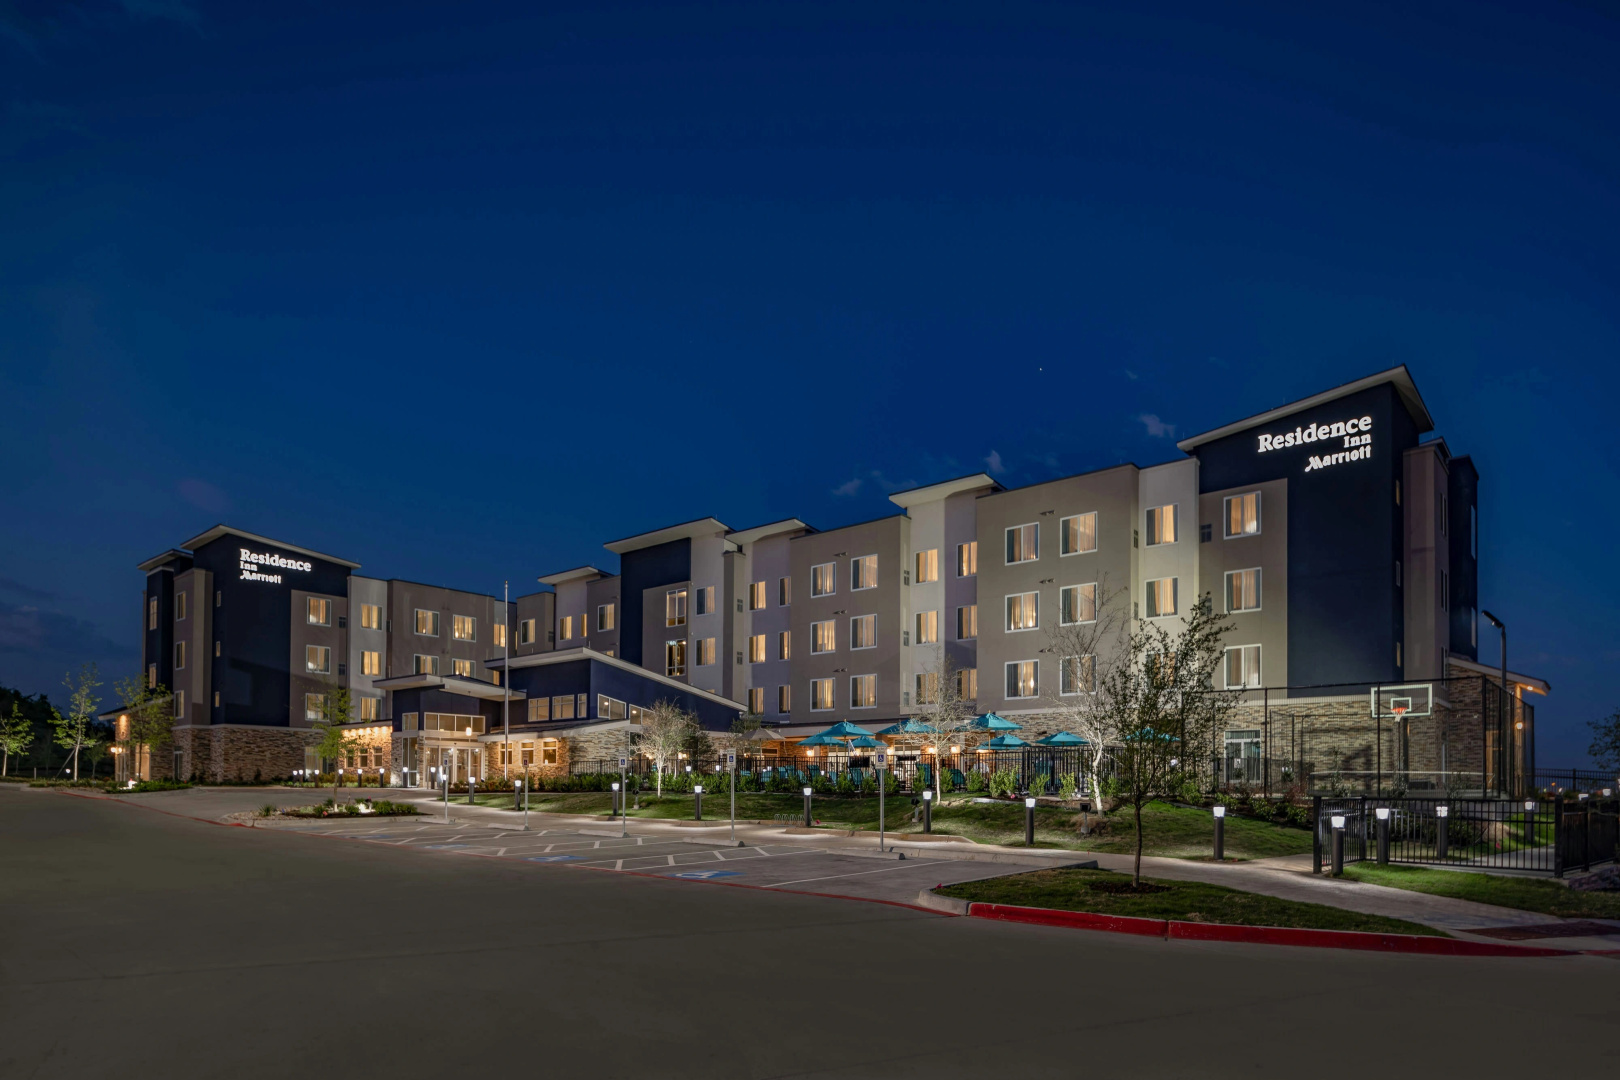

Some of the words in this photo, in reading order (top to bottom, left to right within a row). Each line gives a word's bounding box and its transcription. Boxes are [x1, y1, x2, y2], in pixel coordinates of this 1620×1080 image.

[1258, 416, 1372, 452] Residence
[1344, 434, 1371, 448] Inn
[1305, 445, 1371, 472] Marriott
[240, 549, 311, 571] Residence
[240, 561, 257, 571] Inn
[240, 570, 281, 584] Marriott
